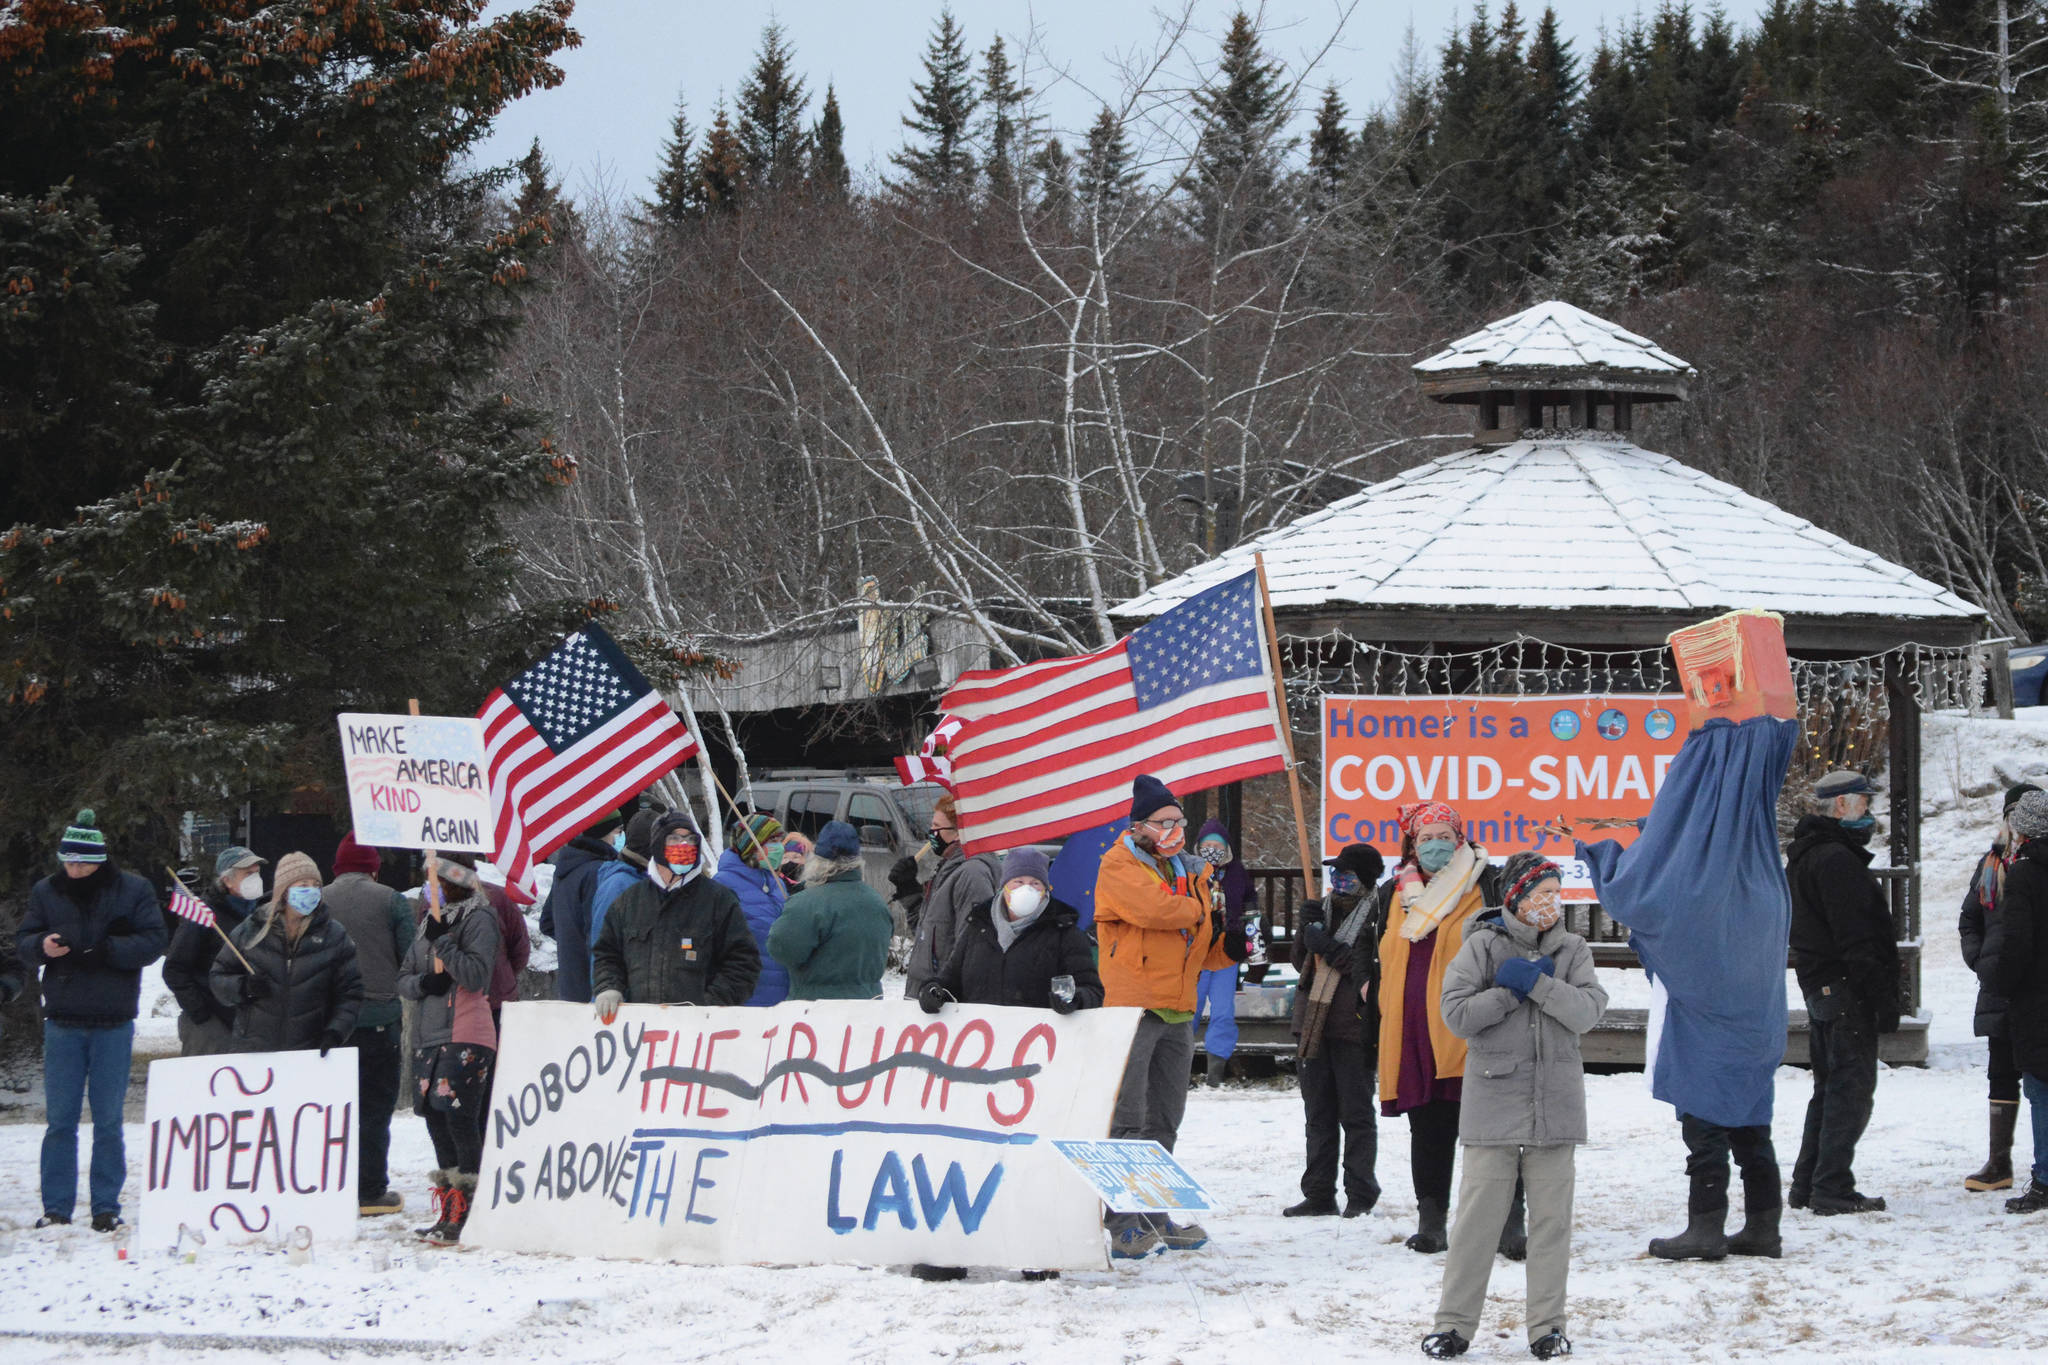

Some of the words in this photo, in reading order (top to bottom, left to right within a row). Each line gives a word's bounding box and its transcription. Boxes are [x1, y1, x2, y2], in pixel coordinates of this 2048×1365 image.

[1330, 708, 1457, 738] Homer
[1469, 706, 1497, 738] is
[1509, 716, 1529, 738] a
[348, 725, 407, 754] MAKE
[396, 758, 482, 790] AMERICA
[370, 783, 421, 813] KIND
[421, 816, 479, 845] AGAIN
[495, 1022, 645, 1149] NOBODY
[640, 1029, 741, 1118] THE
[757, 1018, 1057, 1126] TRUMPS
[149, 1101, 352, 1194] IMPEACH
[491, 1160, 526, 1210] IS
[534, 1136, 638, 1208] ABOVE
[628, 1140, 729, 1226] THE
[827, 1149, 1005, 1235] LAW
